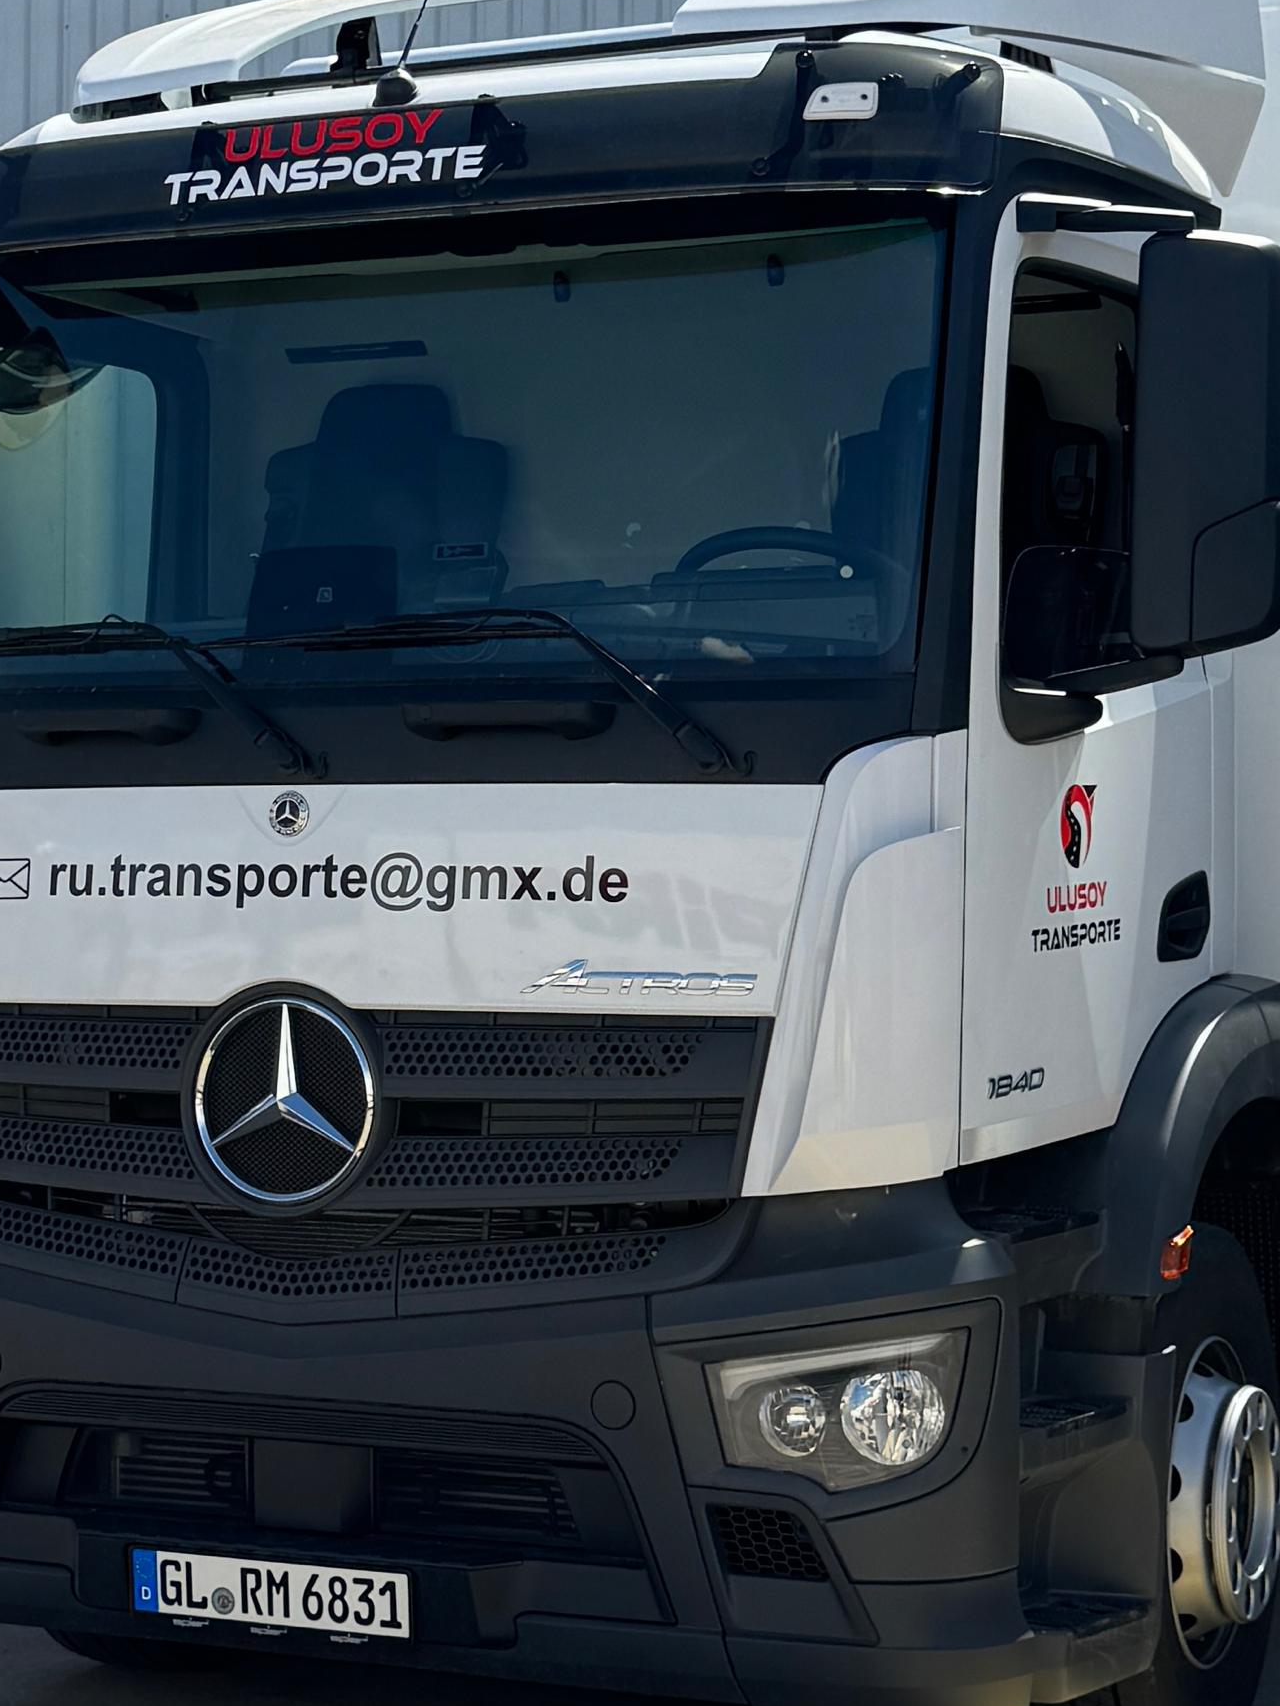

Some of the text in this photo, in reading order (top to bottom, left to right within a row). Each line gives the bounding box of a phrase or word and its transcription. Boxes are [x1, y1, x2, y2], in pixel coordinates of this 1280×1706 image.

[224, 109, 443, 163] ULUSOY
[164, 145, 487, 205] TRANSPORTE
[48, 852, 630, 912] ru.transporte@gmx.de
[1046, 880, 1107, 914] ULUSOY
[1031, 918, 1121, 953] TRANSPORTE
[520, 959, 758, 997] ACTROS
[987, 1067, 1045, 1100] 1840
[141, 1586, 152, 1601] D
[160, 1559, 403, 1630] GL RM 6831
